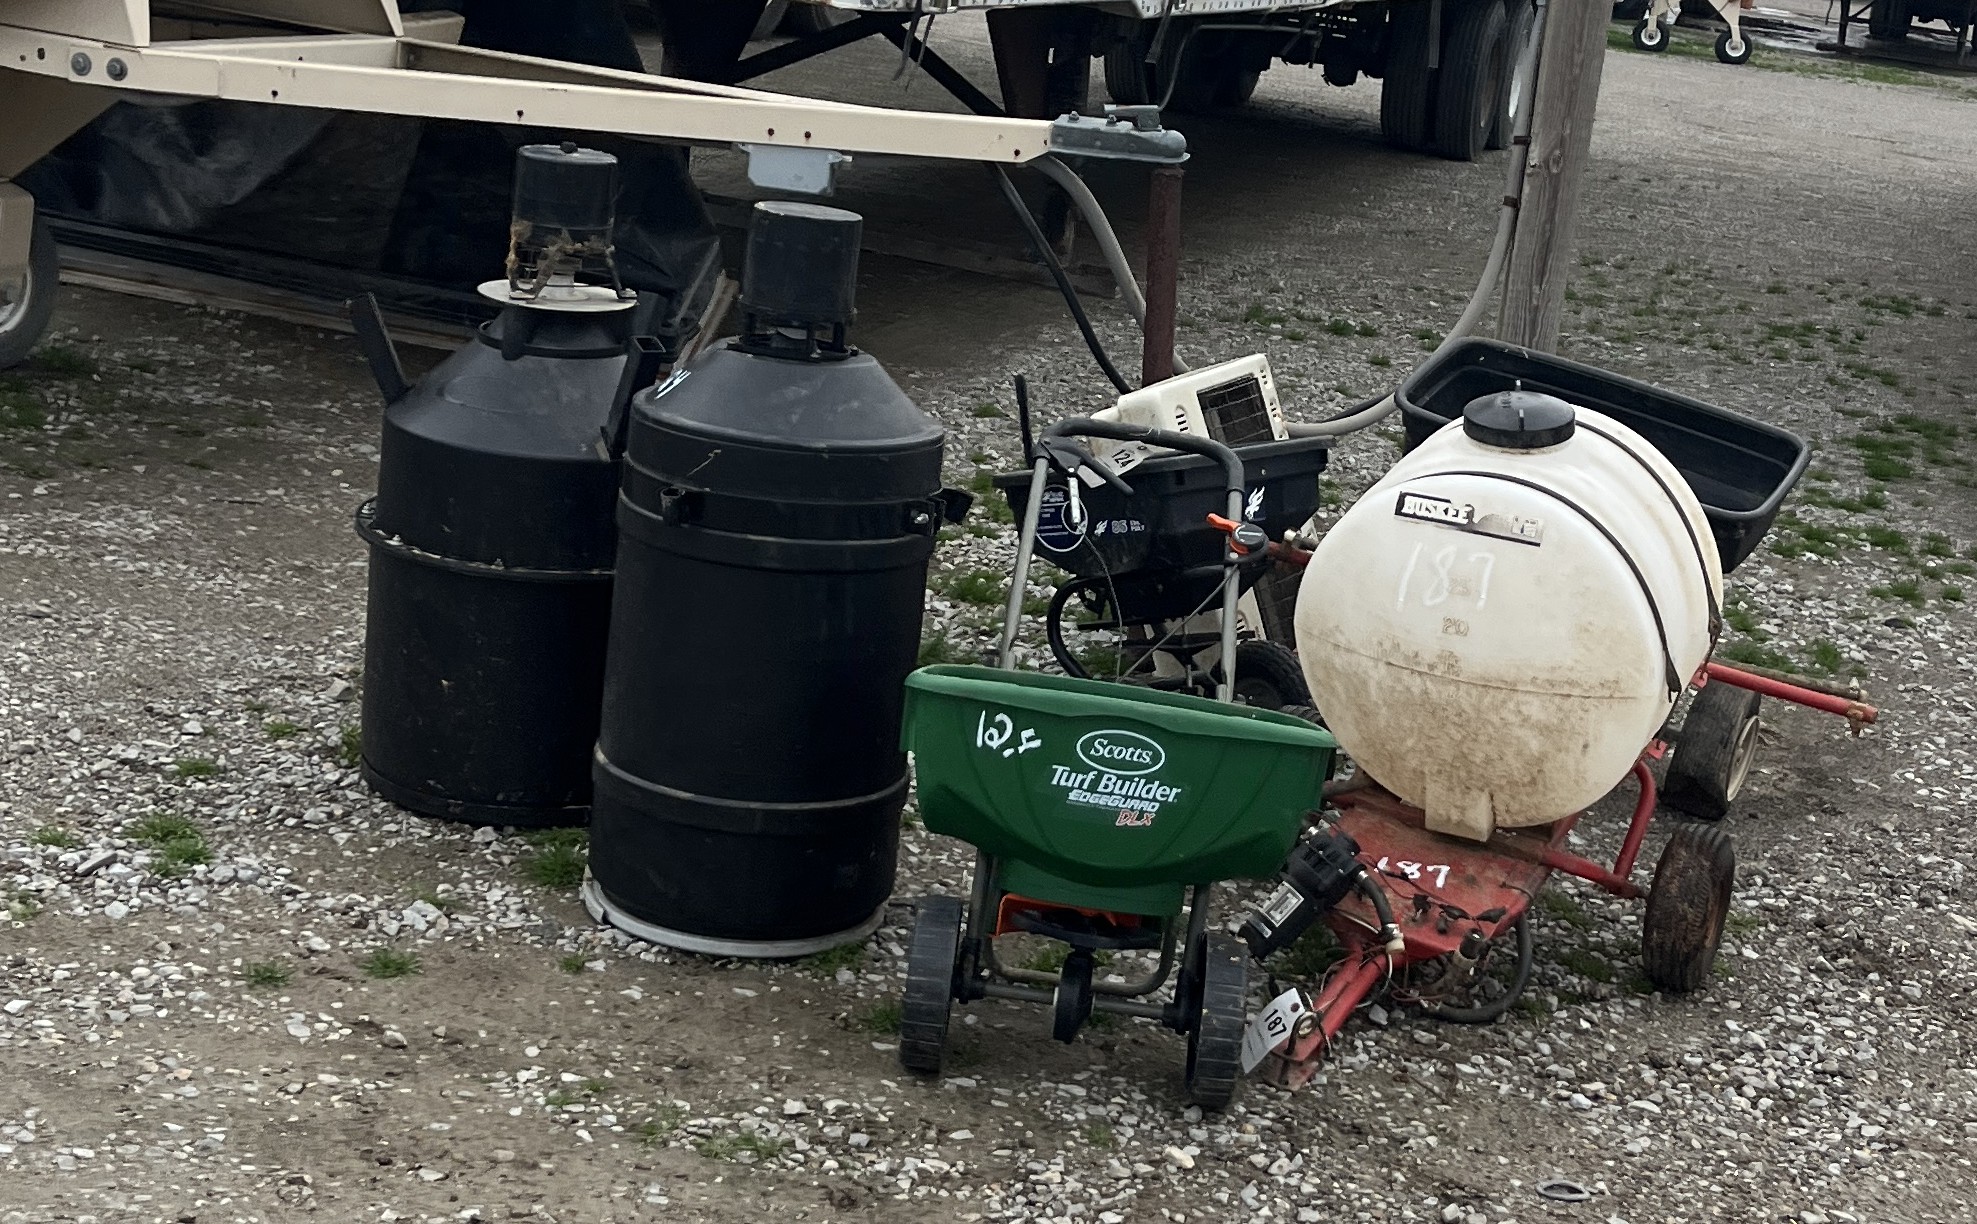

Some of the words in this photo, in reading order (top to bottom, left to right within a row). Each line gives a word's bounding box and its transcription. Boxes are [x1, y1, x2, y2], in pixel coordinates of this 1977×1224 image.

[1393, 542, 1496, 612] 187
[1089, 738, 1153, 764] Scotts
[1050, 764, 1098, 790] Turf
[1096, 773, 1182, 803] Builder
[1115, 808, 1156, 827] DLX
[1377, 856, 1451, 889] 187
[1264, 1009, 1287, 1038] 187
